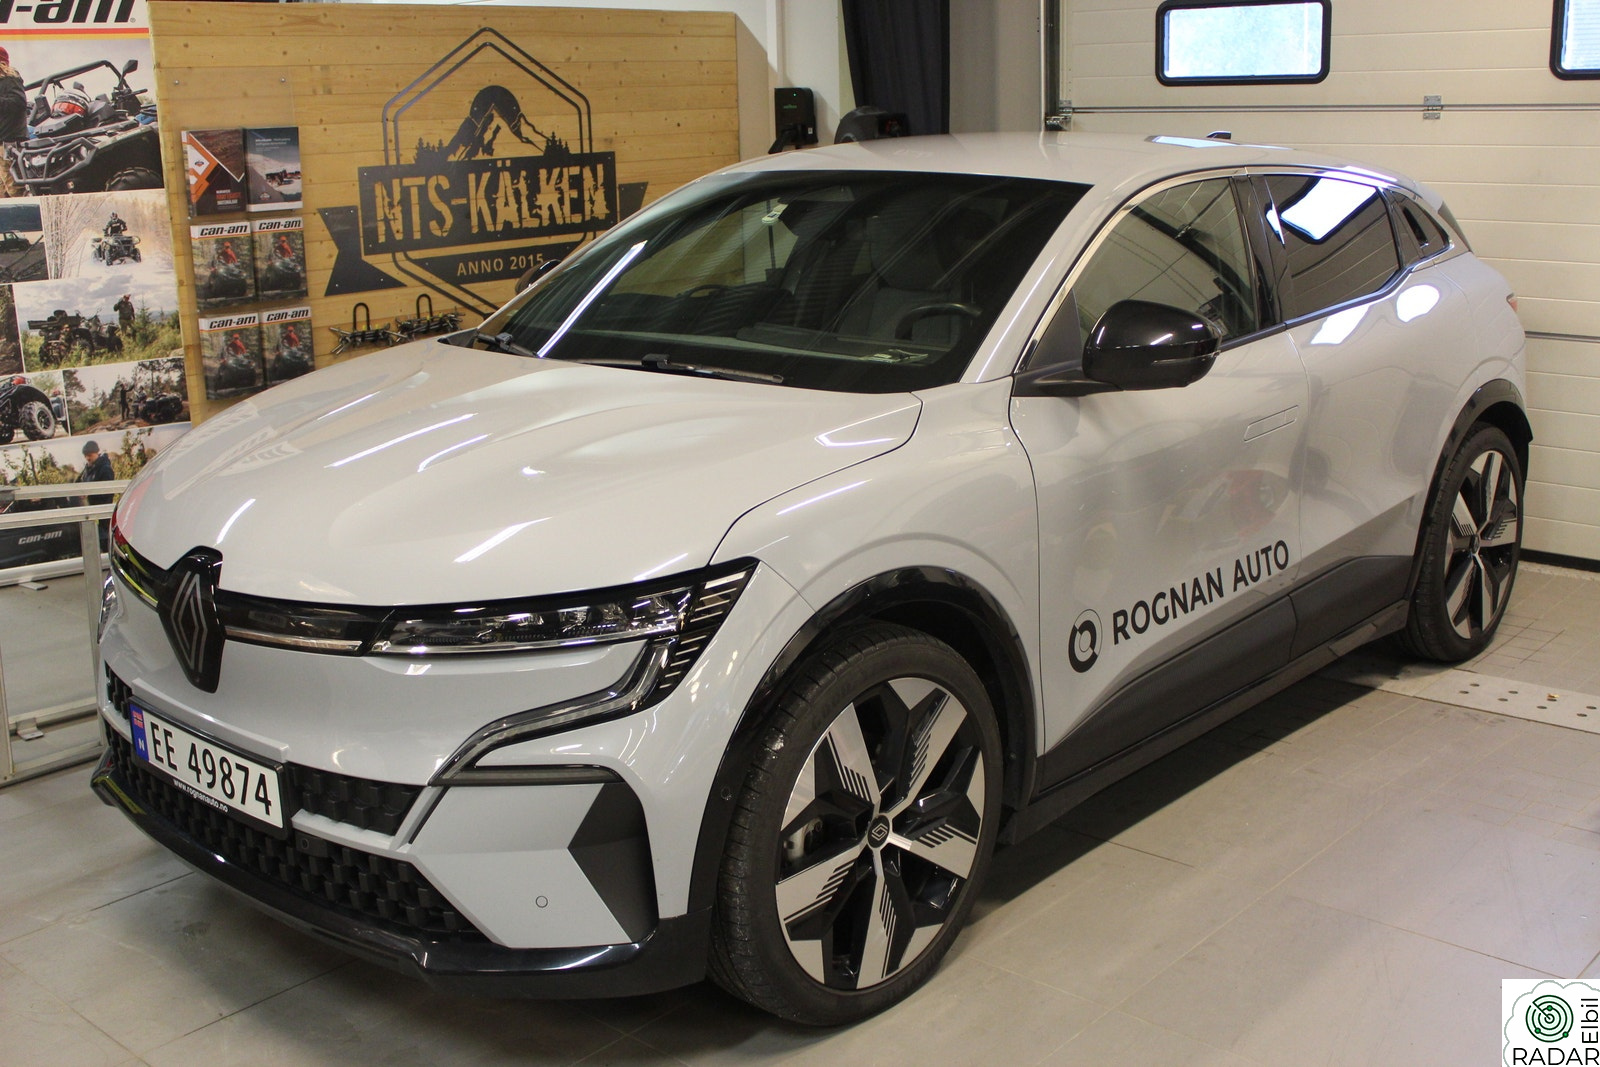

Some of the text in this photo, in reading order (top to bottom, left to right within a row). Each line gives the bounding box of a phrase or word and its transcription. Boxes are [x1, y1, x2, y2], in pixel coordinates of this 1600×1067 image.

[374, 160, 610, 243] NTS-KÄLKEN
[200, 224, 248, 237] can-am
[258, 219, 301, 231] can-am
[457, 253, 544, 277] ANNO 2015
[209, 315, 256, 330] can-am
[266, 308, 309, 322] can-am
[18, 530, 63, 545] can-am
[1112, 540, 1289, 645] ROGNAN AUTO
[138, 737, 146, 751] N
[150, 721, 272, 816] EE 49874
